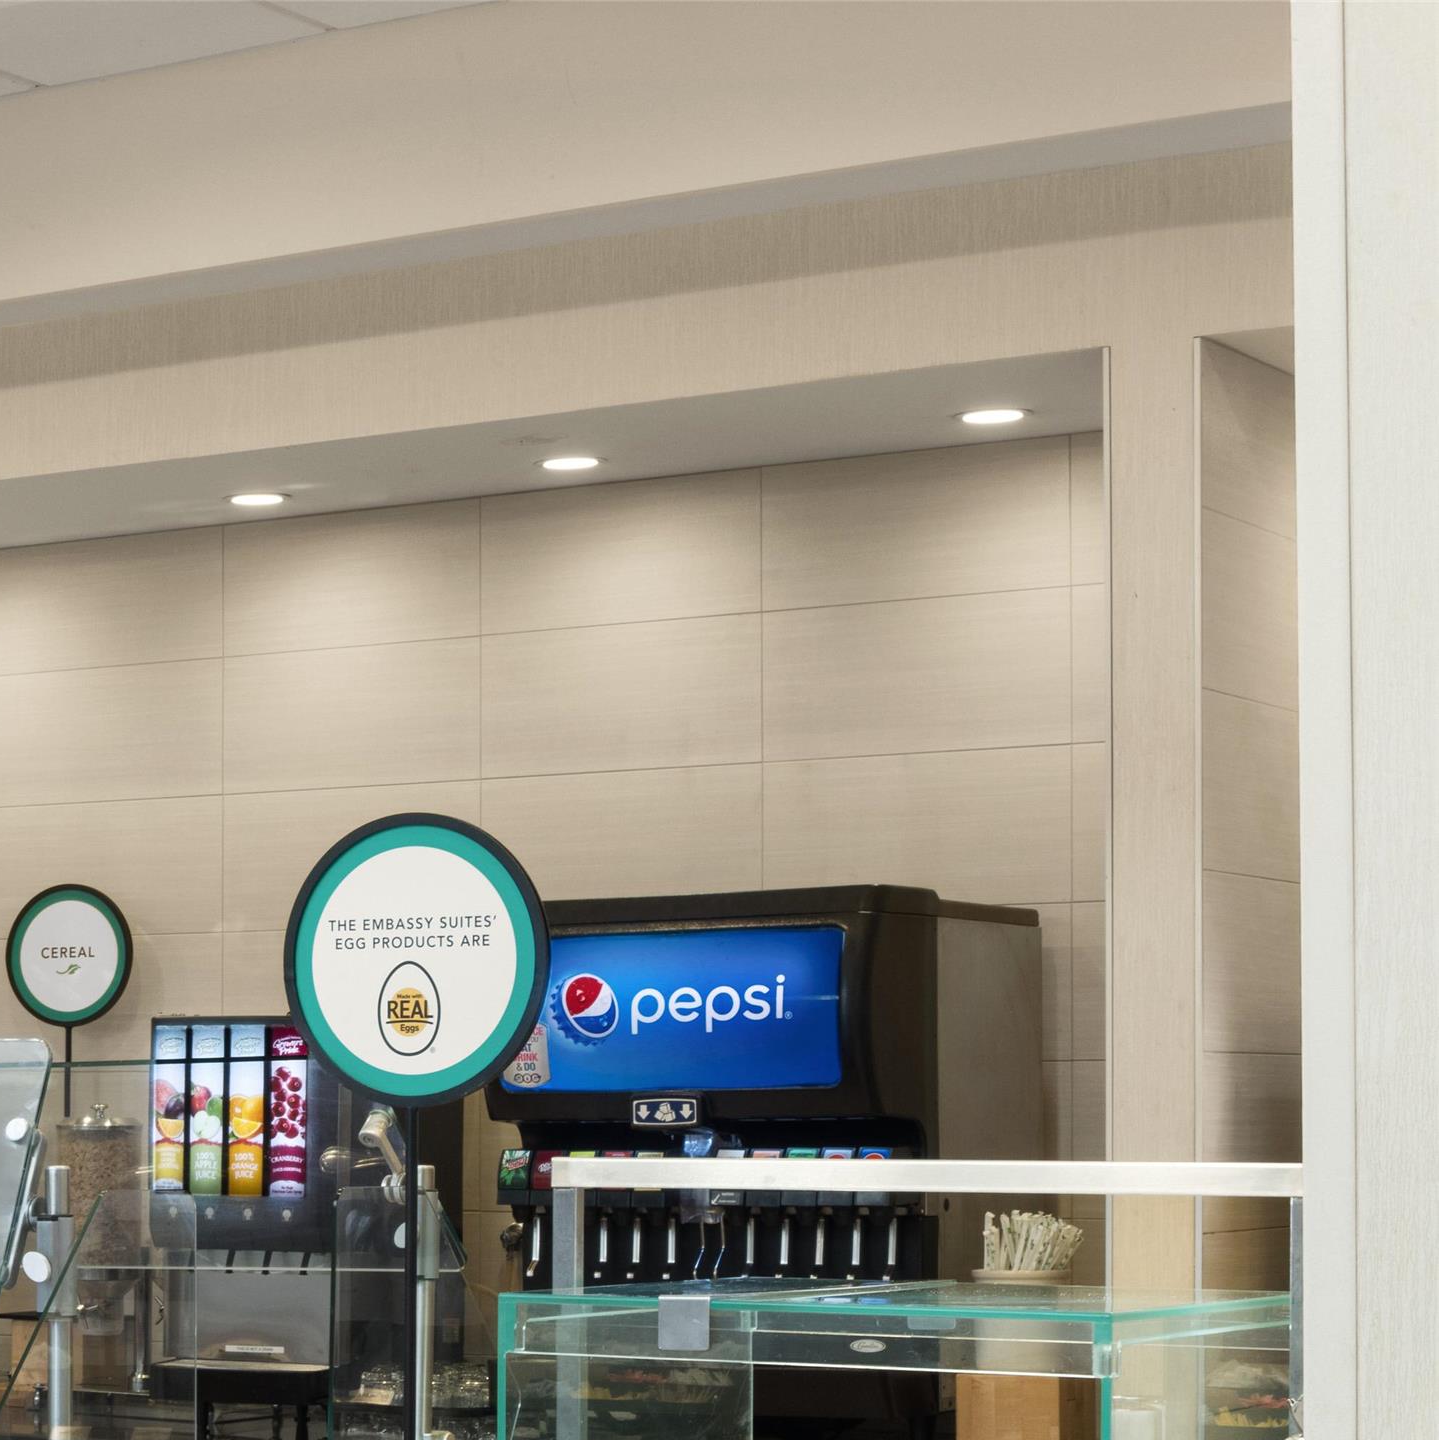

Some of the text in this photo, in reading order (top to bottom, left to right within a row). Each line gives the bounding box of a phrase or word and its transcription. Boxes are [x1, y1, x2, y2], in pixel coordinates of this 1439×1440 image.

[328, 919, 357, 932] THE
[362, 917, 434, 931] EMBASSY
[335, 934, 490, 950] EGG PRODUCTS ARE
[40, 946, 95, 959] CEREAL
[387, 1000, 433, 1019] REAL
[631, 974, 786, 1035] pepsi
[400, 1024, 419, 1033] Eggs
[516, 1052, 539, 1062] RINK
[524, 1062, 536, 1072] DO
[270, 1155, 303, 1164] CRANBERRY
[194, 1160, 217, 1170] APPLE
[195, 1169, 217, 1180] JUICE
[234, 1170, 255, 1180] JUICE
